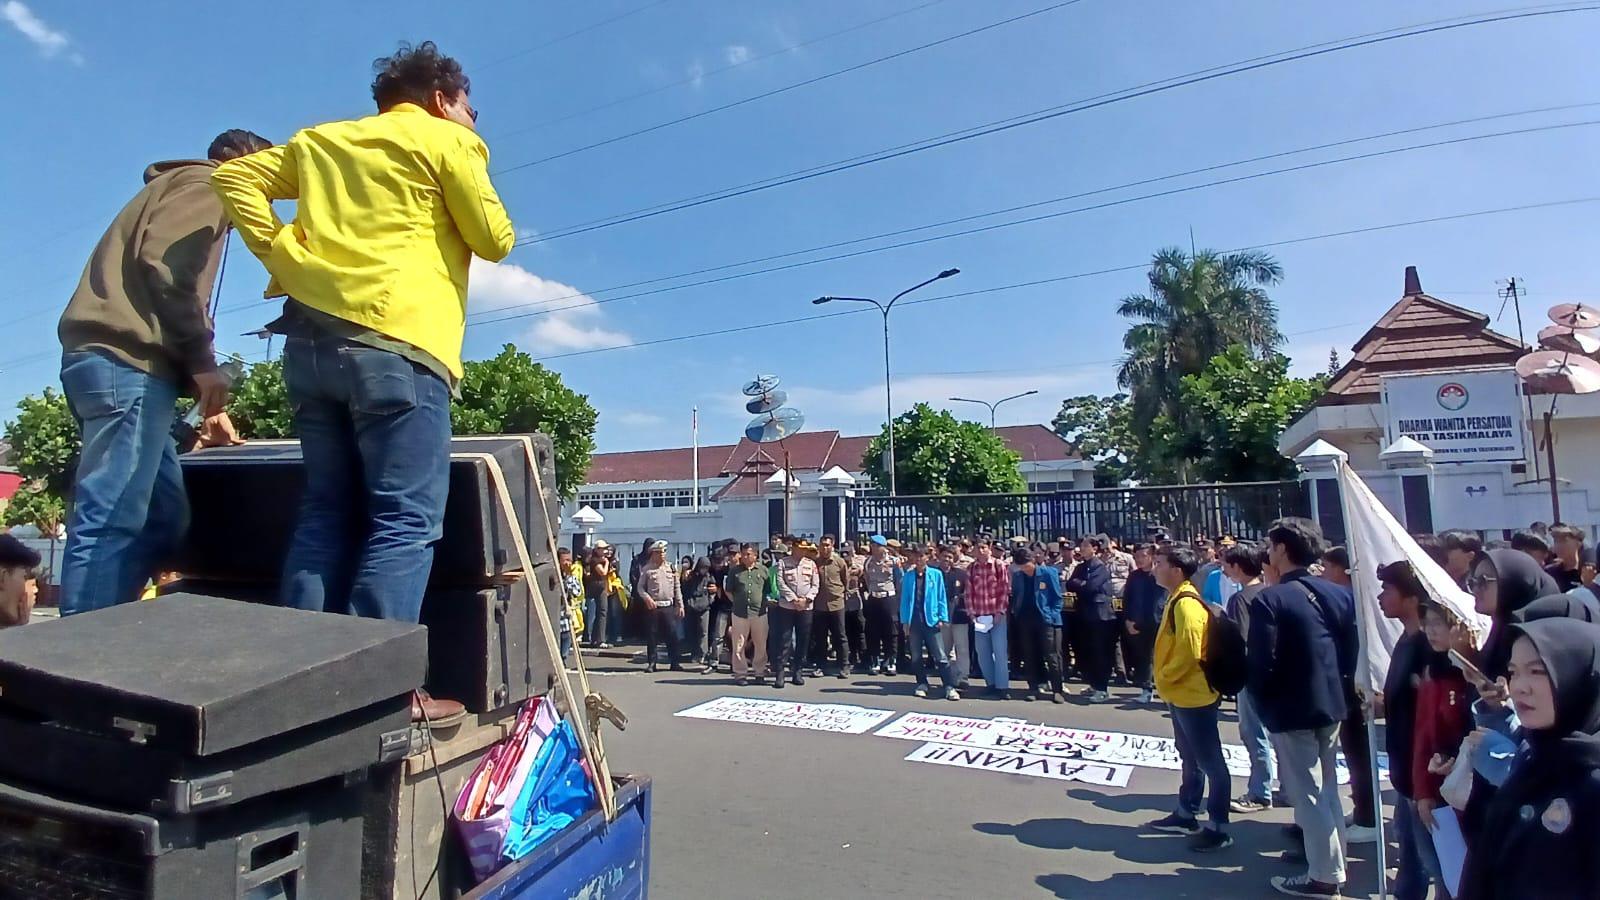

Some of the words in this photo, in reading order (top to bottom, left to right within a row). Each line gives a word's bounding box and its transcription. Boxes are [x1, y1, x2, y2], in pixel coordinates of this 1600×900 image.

[1399, 419, 1434, 433] DHARMA
[1434, 417, 1466, 431] WANITA
[1467, 416, 1512, 430] PERSATUAN
[1433, 430, 1512, 440] TASIKMALAYA
[895, 725, 977, 743] TASIK
[924, 747, 1117, 781] LAWAN!!
